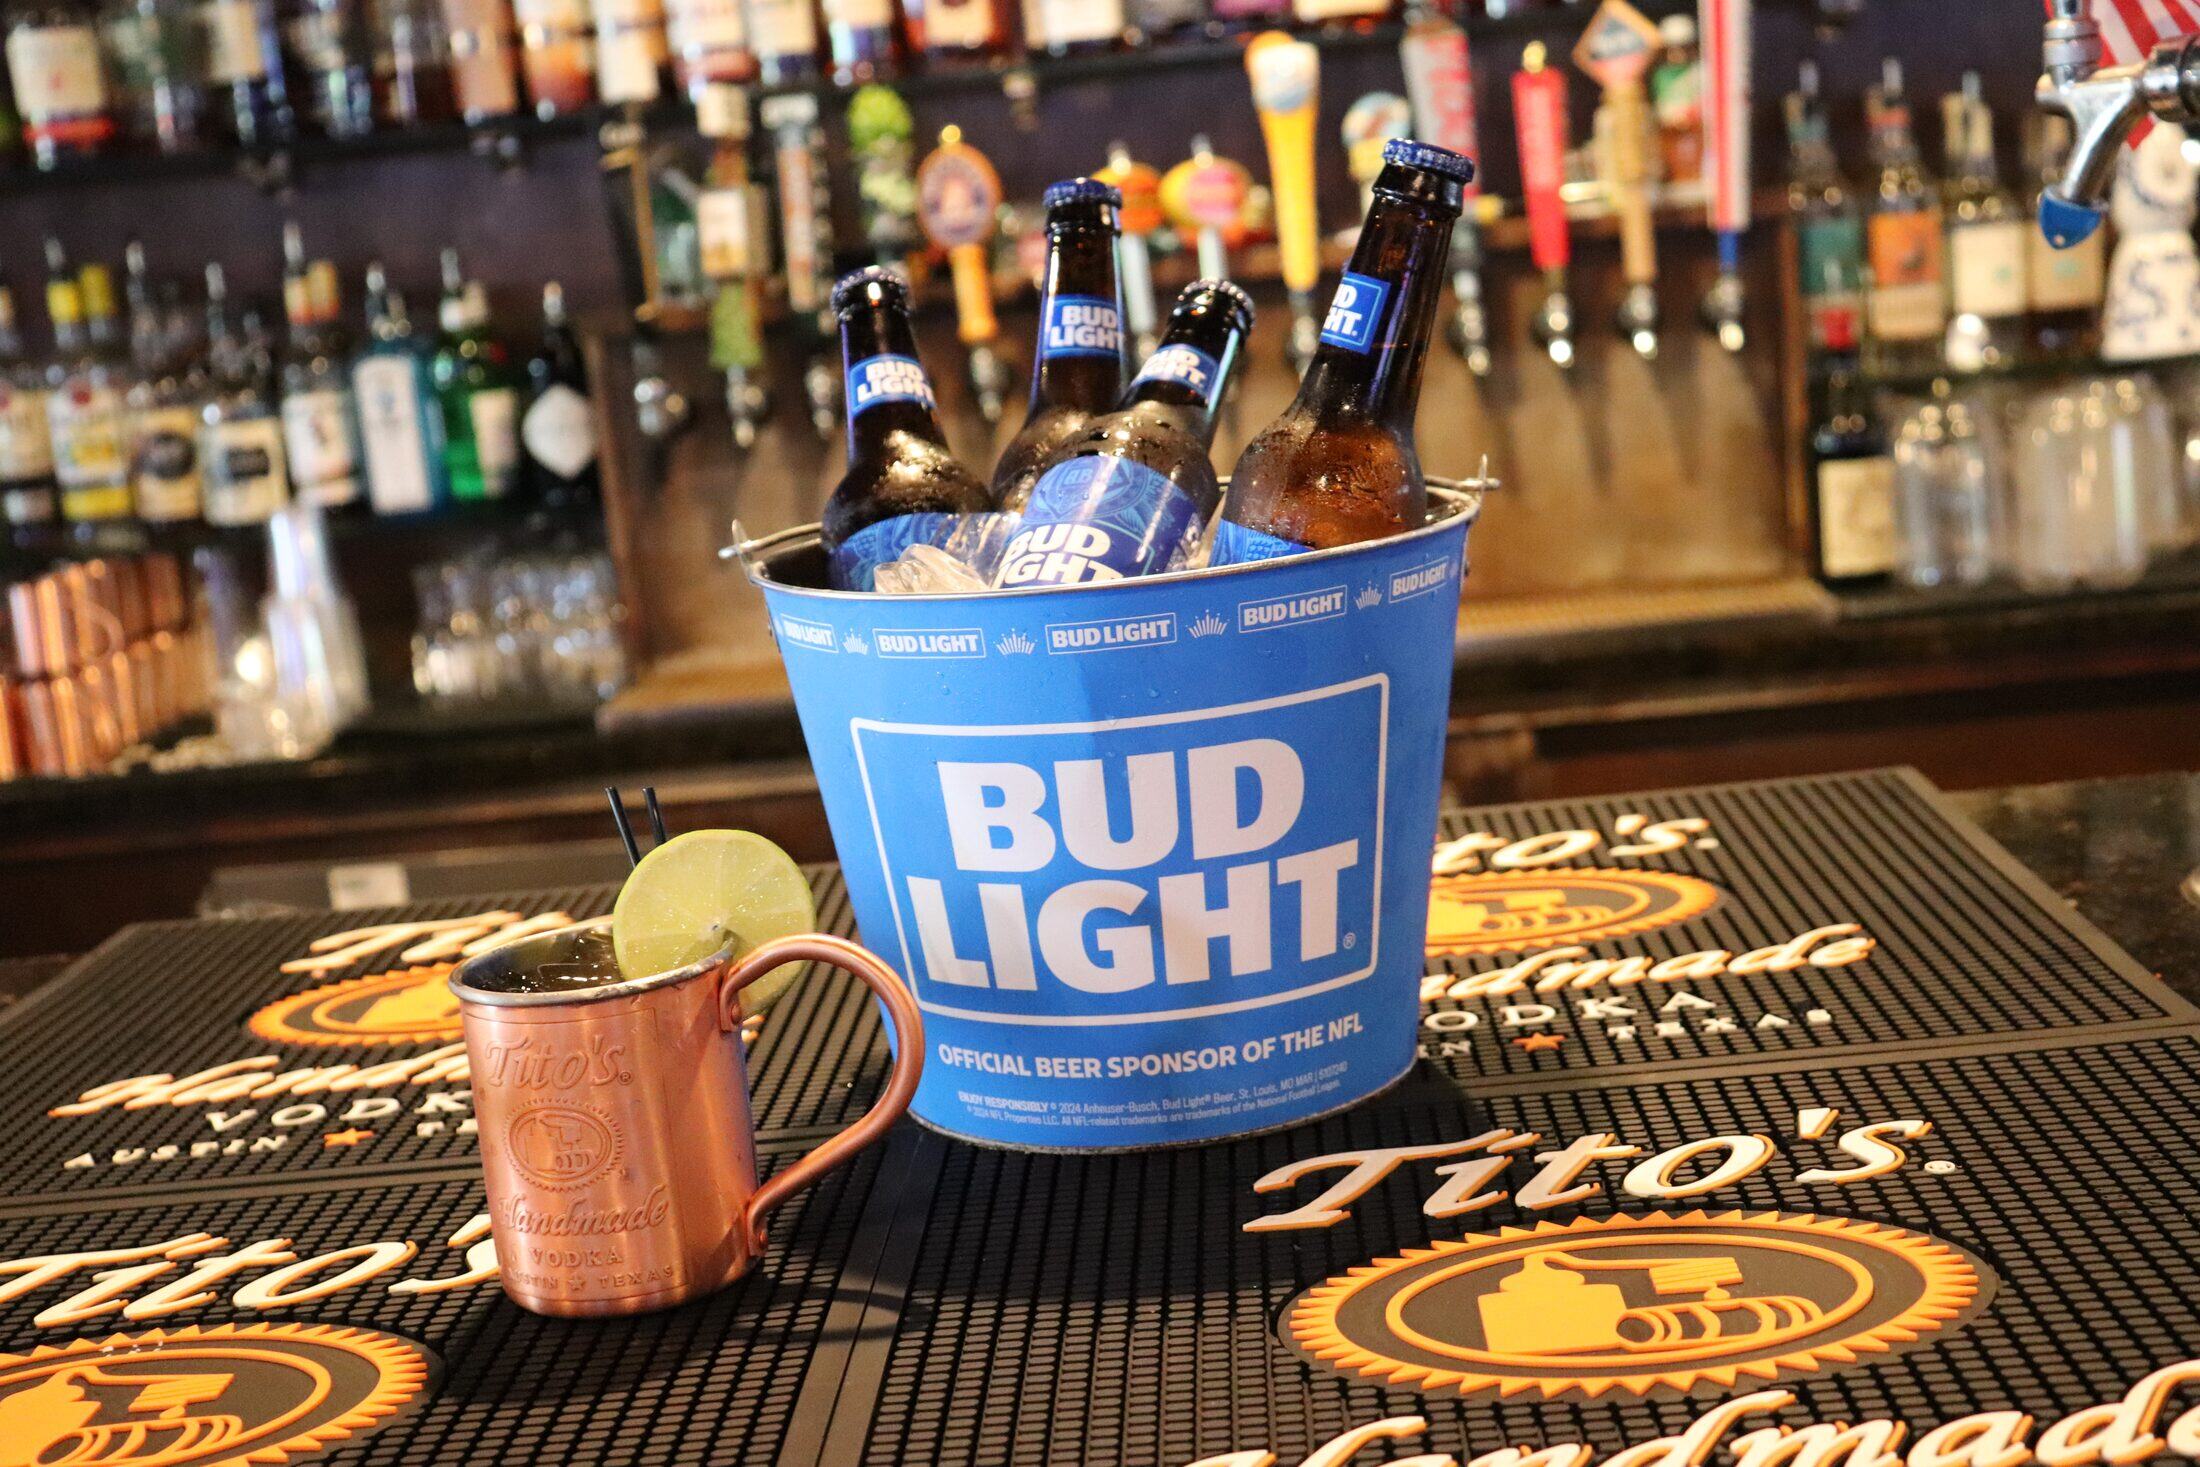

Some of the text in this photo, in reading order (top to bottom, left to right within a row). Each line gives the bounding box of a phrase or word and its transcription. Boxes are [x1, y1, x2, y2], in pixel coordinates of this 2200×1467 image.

[1062, 305, 1118, 328] BUD
[1001, 523, 1111, 563] BUD
[992, 553, 1125, 589] IGHT
[1392, 564, 1447, 597] BUD LIGHT
[1244, 592, 1344, 626] BUD LIGHT
[802, 625, 833, 647] LIGHT
[878, 635, 979, 653] BUD LIGHT
[1052, 620, 1170, 648] BUD LIGHT
[937, 738, 1305, 873] BUD
[1431, 814, 1711, 873] to's
[1423, 991, 1717, 1032] ODKA
[938, 1012, 1364, 1079] OFFICIAL BEER SPONSOR OF THE NFL
[205, 1089, 473, 1132] VODK
[984, 1095, 1049, 1113] RESPONSIBLY
[1059, 1103, 1081, 1114] 2024
[1162, 1099, 1181, 1110] Bud
[1280, 1078, 1294, 1091] MO
[990, 1109, 1004, 1121] NFL
[1121, 1112, 1168, 1126] trademarks
[1170, 1112, 1183, 1123] are
[1185, 1106, 1231, 1121] trademarks
[1232, 1103, 1242, 1113] of
[1243, 1101, 1256, 1112] the
[1242, 1106, 1936, 1233] Tito's
[499, 1184, 670, 1237] Handmade
[530, 1245, 624, 1268] VODKA
[597, 1265, 675, 1289] TEXAS
